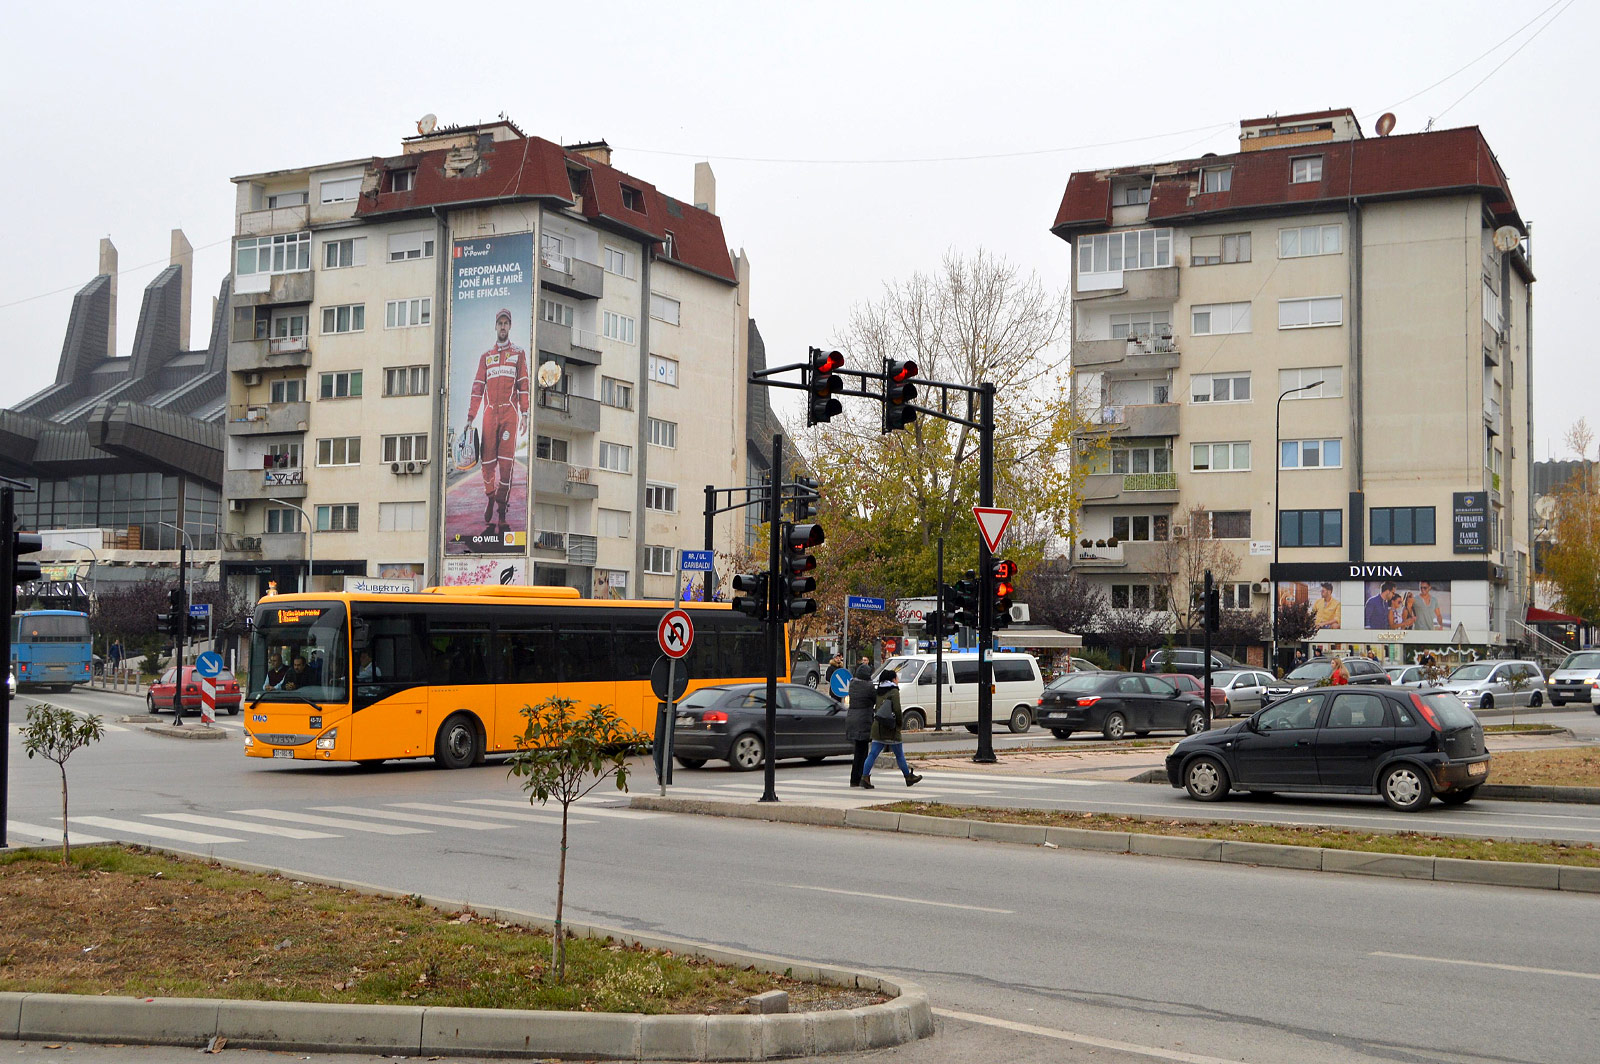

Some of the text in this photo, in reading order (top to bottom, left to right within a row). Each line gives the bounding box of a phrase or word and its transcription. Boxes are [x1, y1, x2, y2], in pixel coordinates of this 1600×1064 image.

[459, 263, 520, 277] PERFORMANCA
[458, 272, 522, 288] JONË MË E MIRË
[458, 287, 510, 300] DHE EFIKASE.
[1350, 565, 1403, 577] DIVINA
[365, 584, 400, 592] LIBERTY
